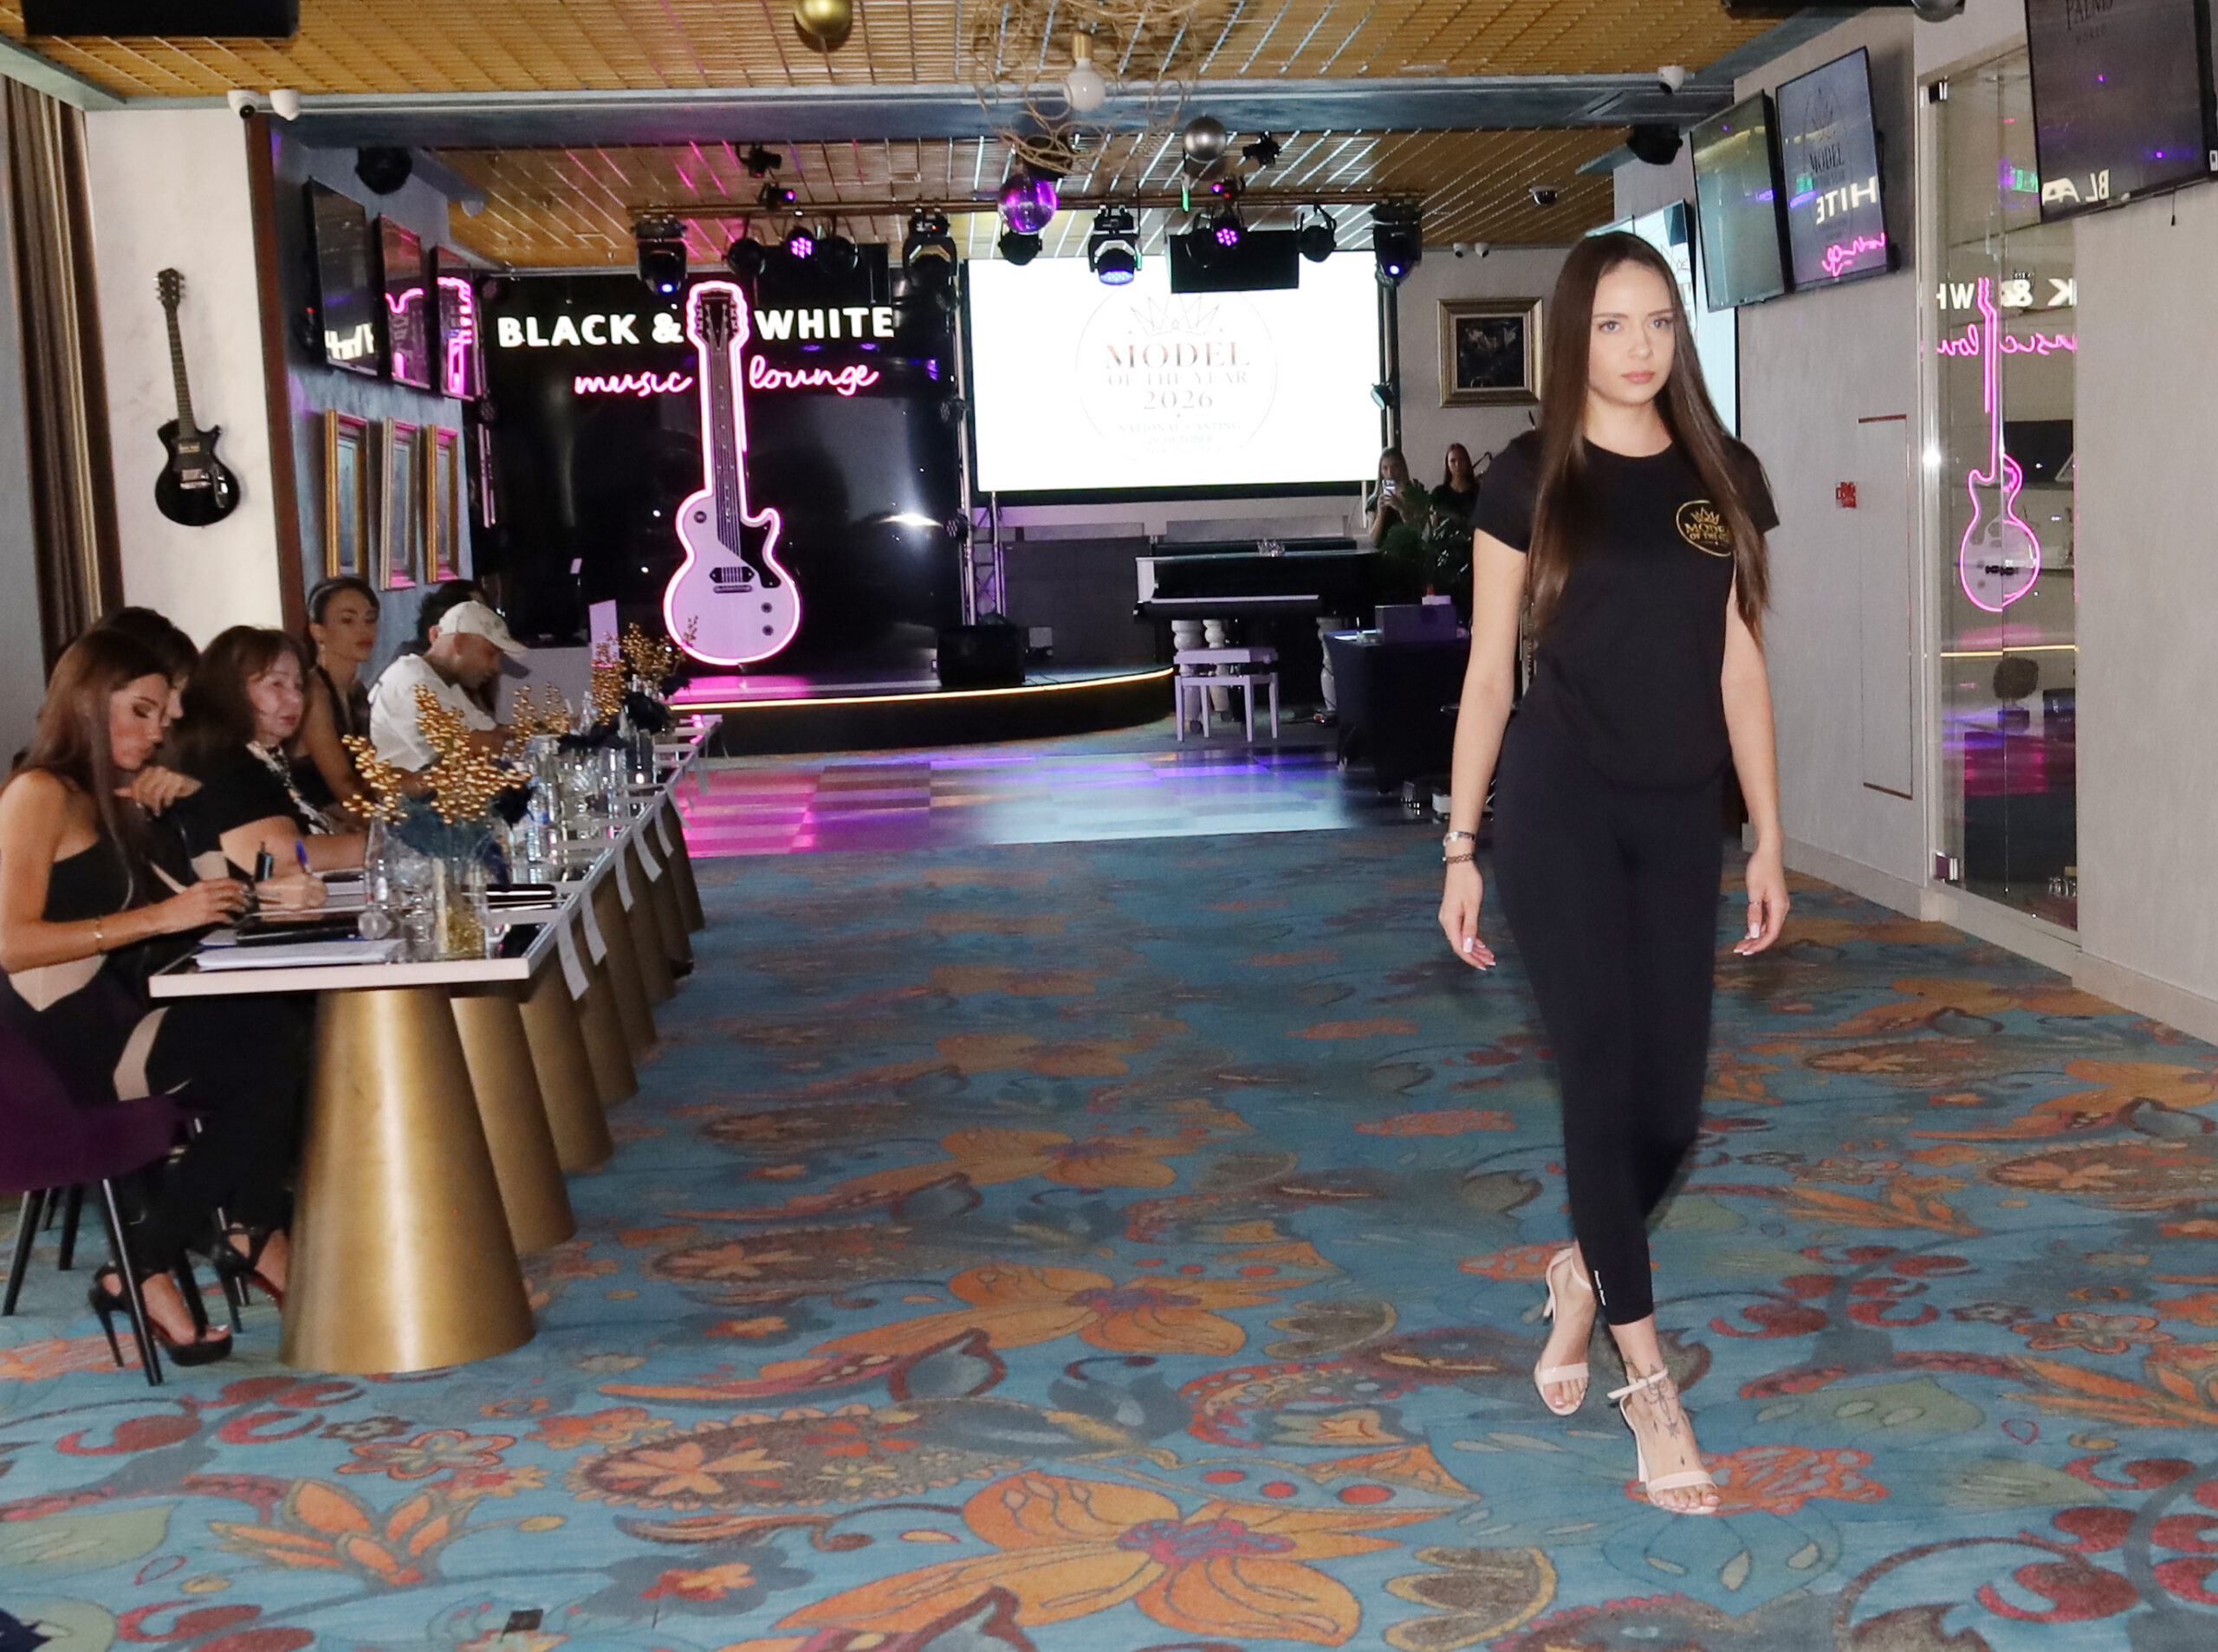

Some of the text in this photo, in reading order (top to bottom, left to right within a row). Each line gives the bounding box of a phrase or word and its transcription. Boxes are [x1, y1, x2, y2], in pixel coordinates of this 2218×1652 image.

[1809, 144, 1845, 174] MODEL
[497, 307, 895, 347] BLACK & WHITE
[1106, 341, 1250, 369] MODEL
[574, 355, 879, 397] music lounge
[1108, 370, 1248, 386] OF THE YEAR
[1144, 390, 1213, 410] 2026
